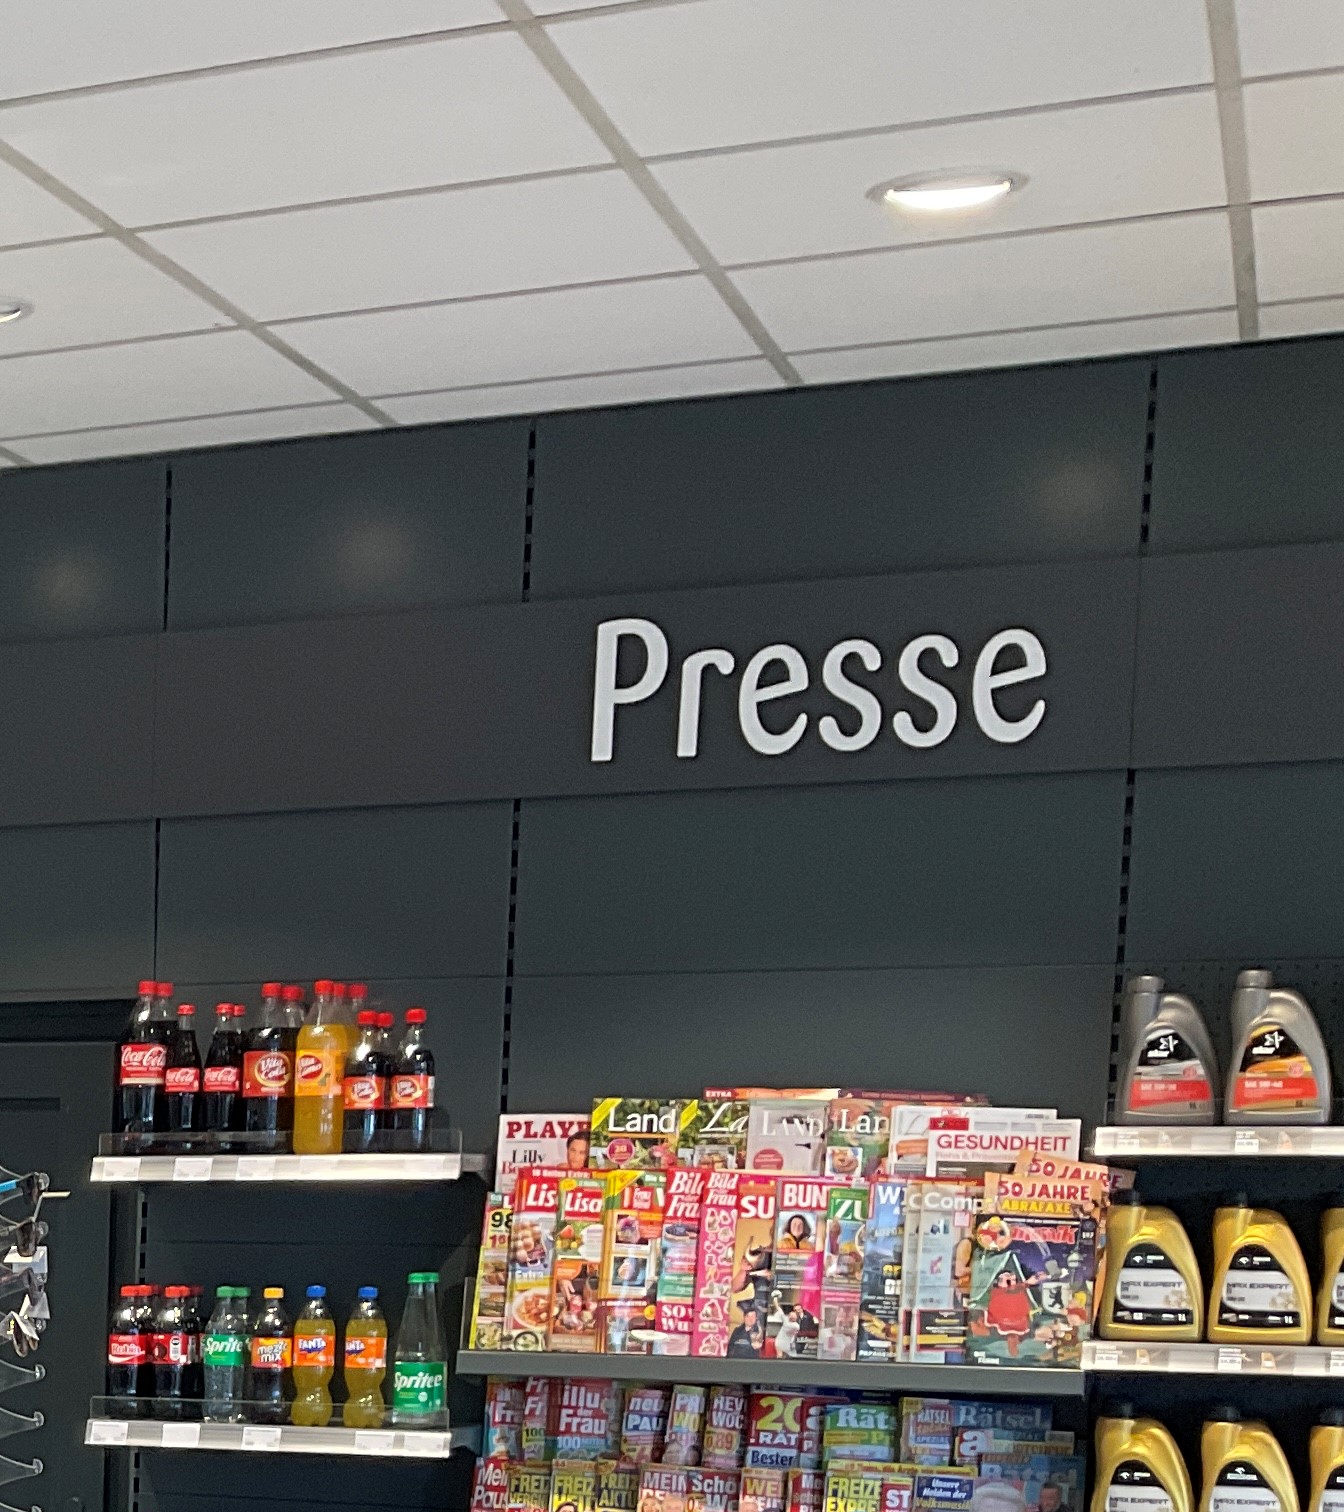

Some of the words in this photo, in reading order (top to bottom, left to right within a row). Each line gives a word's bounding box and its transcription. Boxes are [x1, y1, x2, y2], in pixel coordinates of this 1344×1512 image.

[591, 617, 1047, 762] Presse
[260, 1059, 283, 1072] Vita
[261, 1066, 287, 1079] Cola
[609, 1107, 676, 1133] Land
[936, 1133, 1072, 1153] GESUNDHEIT
[708, 1171, 738, 1191] Bild
[997, 1180, 1023, 1195] 50
[1027, 1182, 1091, 1201] JAHRE
[564, 1191, 602, 1214] Lisa
[705, 1190, 736, 1207] Frau
[1001, 1199, 1072, 1214] ABRAFAXE
[205, 1336, 244, 1356] Sprite
[298, 1337, 327, 1353] FANTA
[259, 1350, 282, 1363] mix
[563, 1385, 601, 1409] illu
[560, 1410, 606, 1436] Frau
[958, 1404, 1042, 1431] Rätsel
[751, 1450, 795, 1467] Bester
